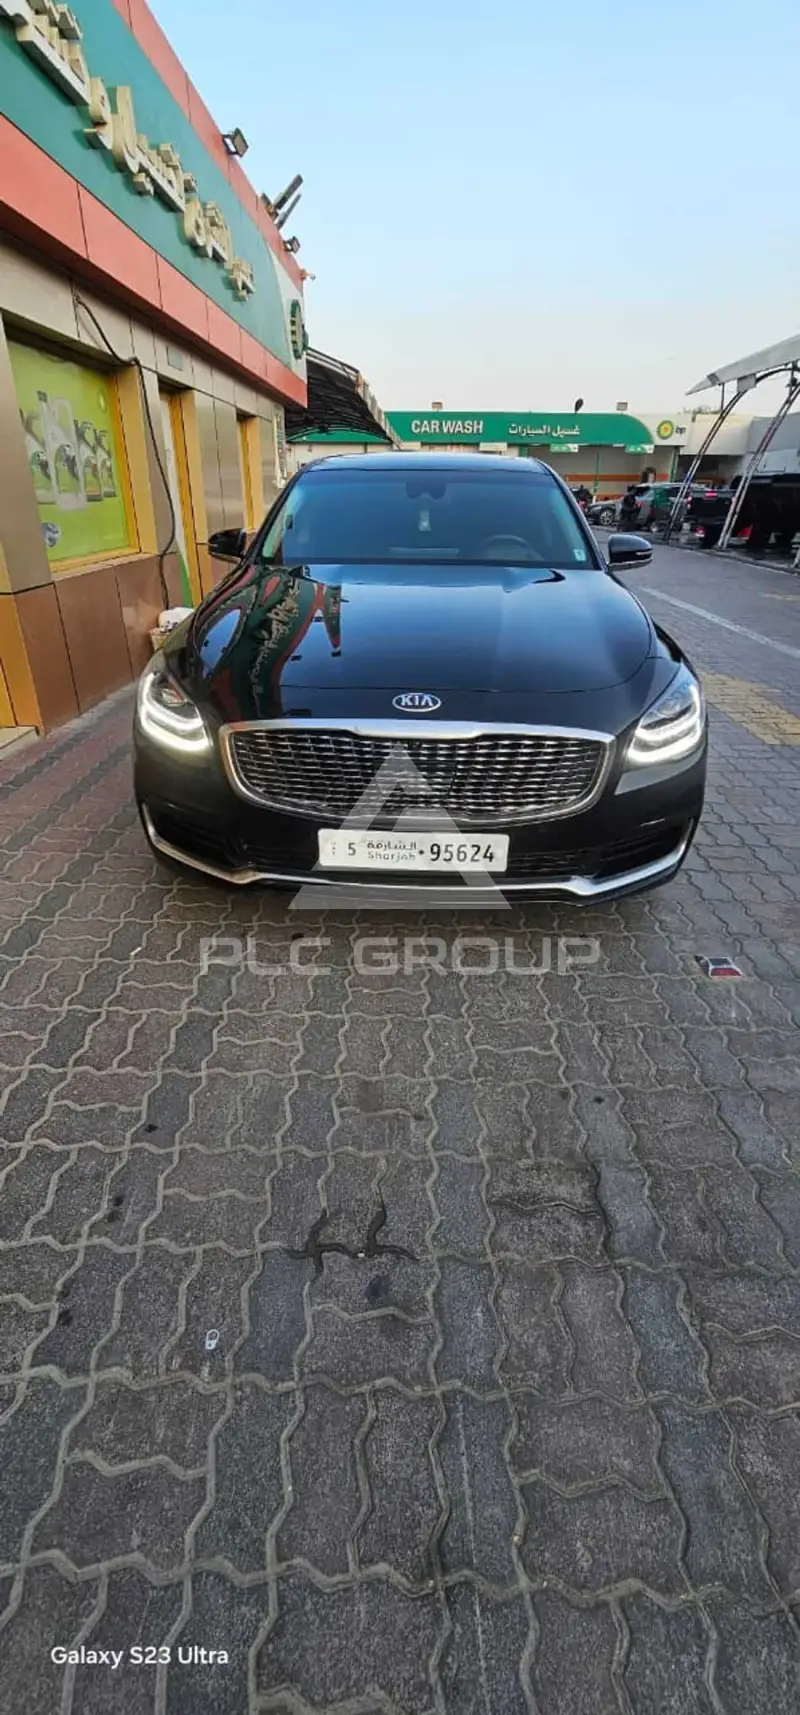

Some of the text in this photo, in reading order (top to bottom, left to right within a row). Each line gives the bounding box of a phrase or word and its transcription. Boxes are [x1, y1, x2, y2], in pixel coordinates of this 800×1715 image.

[411, 419, 484, 435] CAR WASH
[508, 422, 581, 438] غسيل السيارات
[347, 842, 357, 857] 5
[429, 843, 495, 863] 95624
[367, 850, 416, 863] Sharjah
